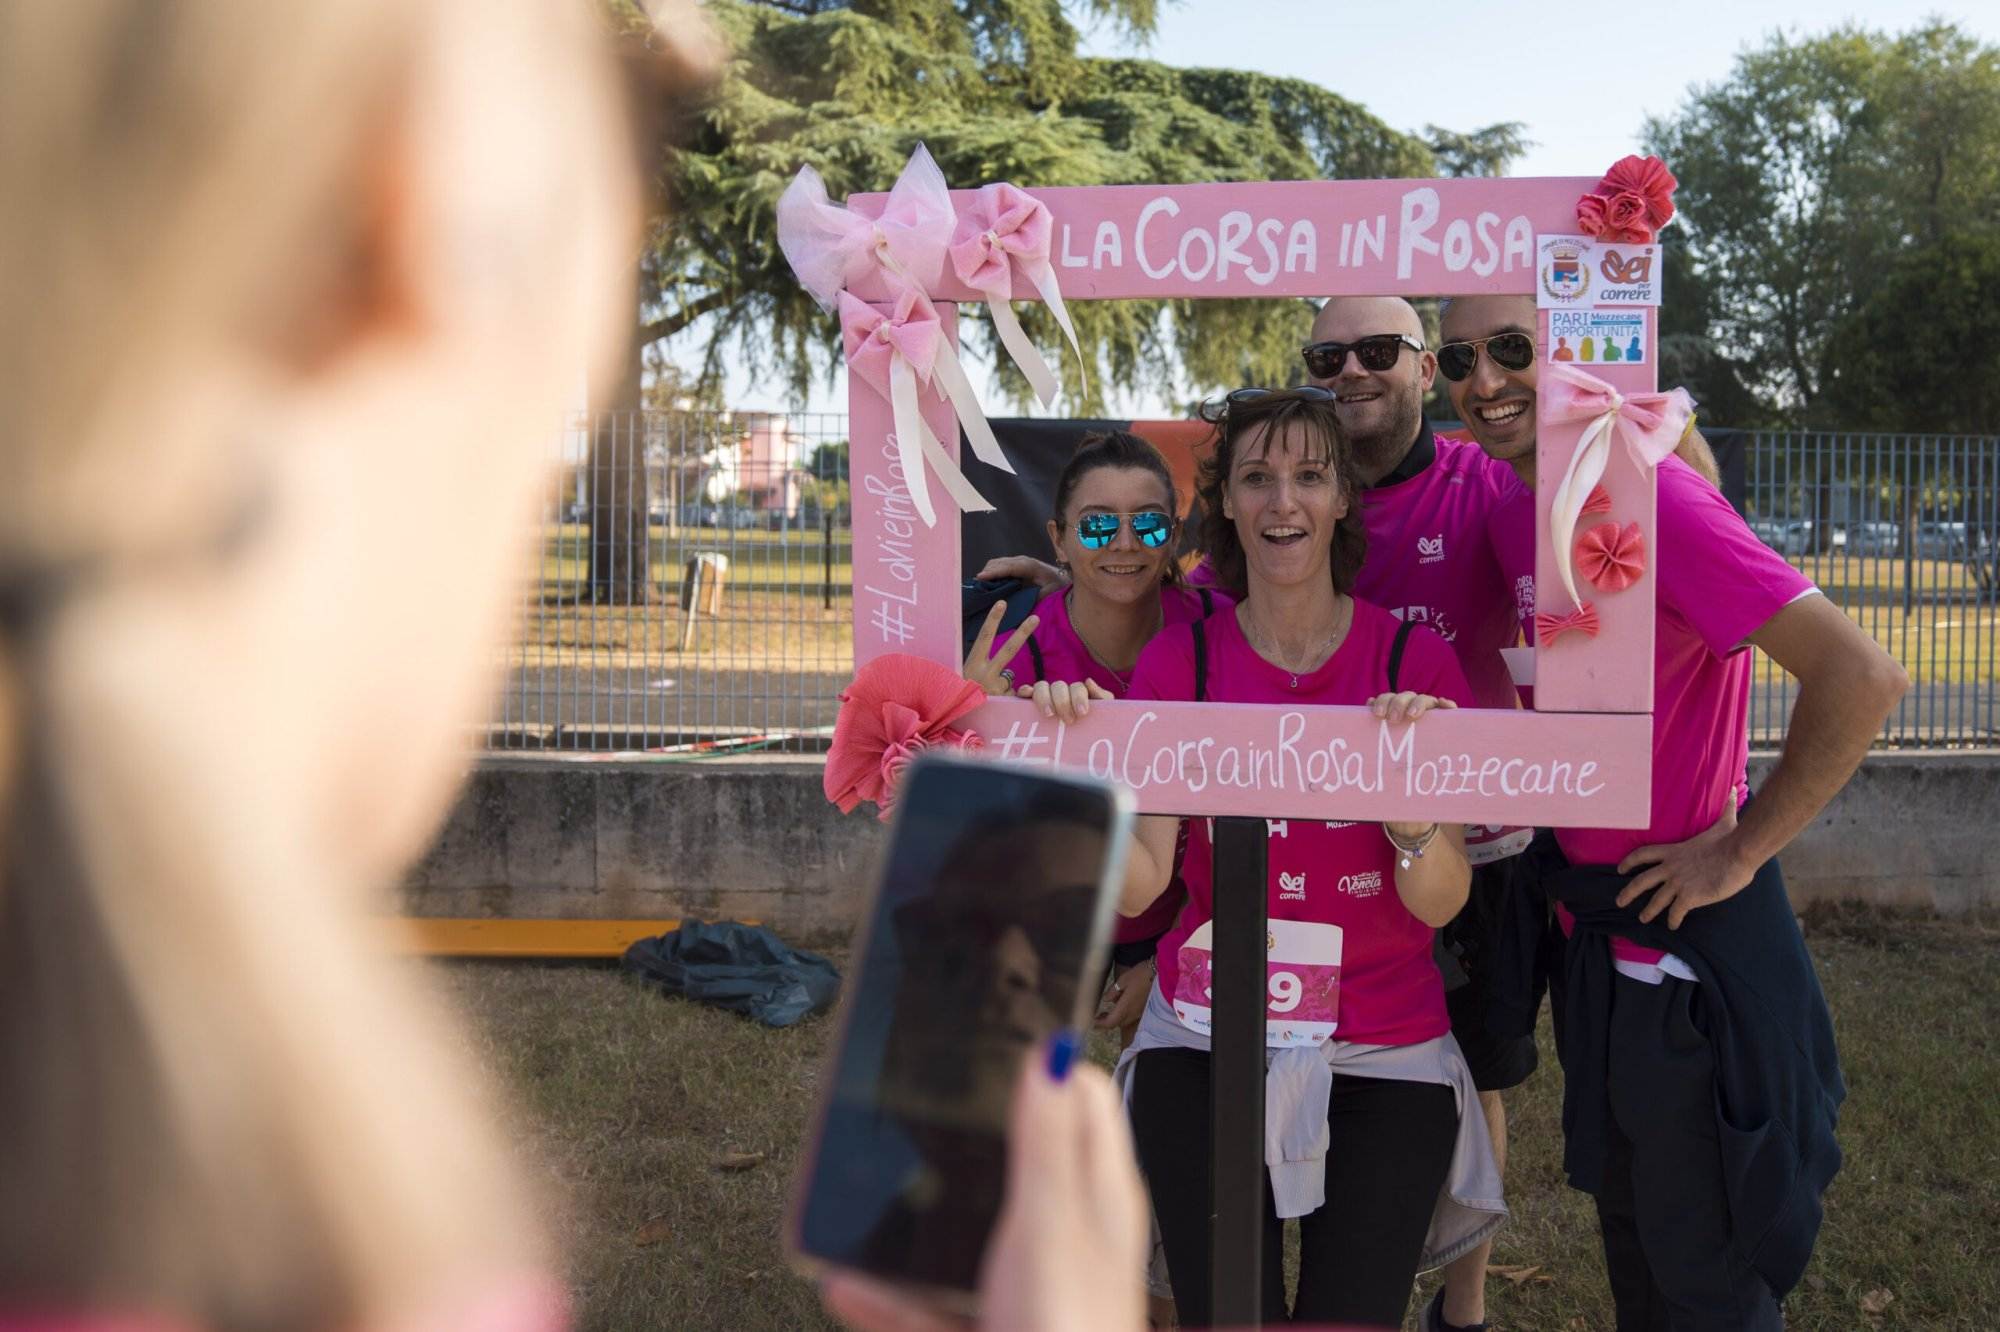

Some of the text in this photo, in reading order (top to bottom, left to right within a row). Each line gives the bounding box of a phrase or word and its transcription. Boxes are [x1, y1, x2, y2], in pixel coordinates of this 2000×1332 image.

[1061, 187, 1534, 286] LA CORSA IN ROSA
[1601, 248, 1653, 285] Sei
[1600, 289, 1651, 301] correre
[1553, 312, 1642, 326] PARI Mozzecane
